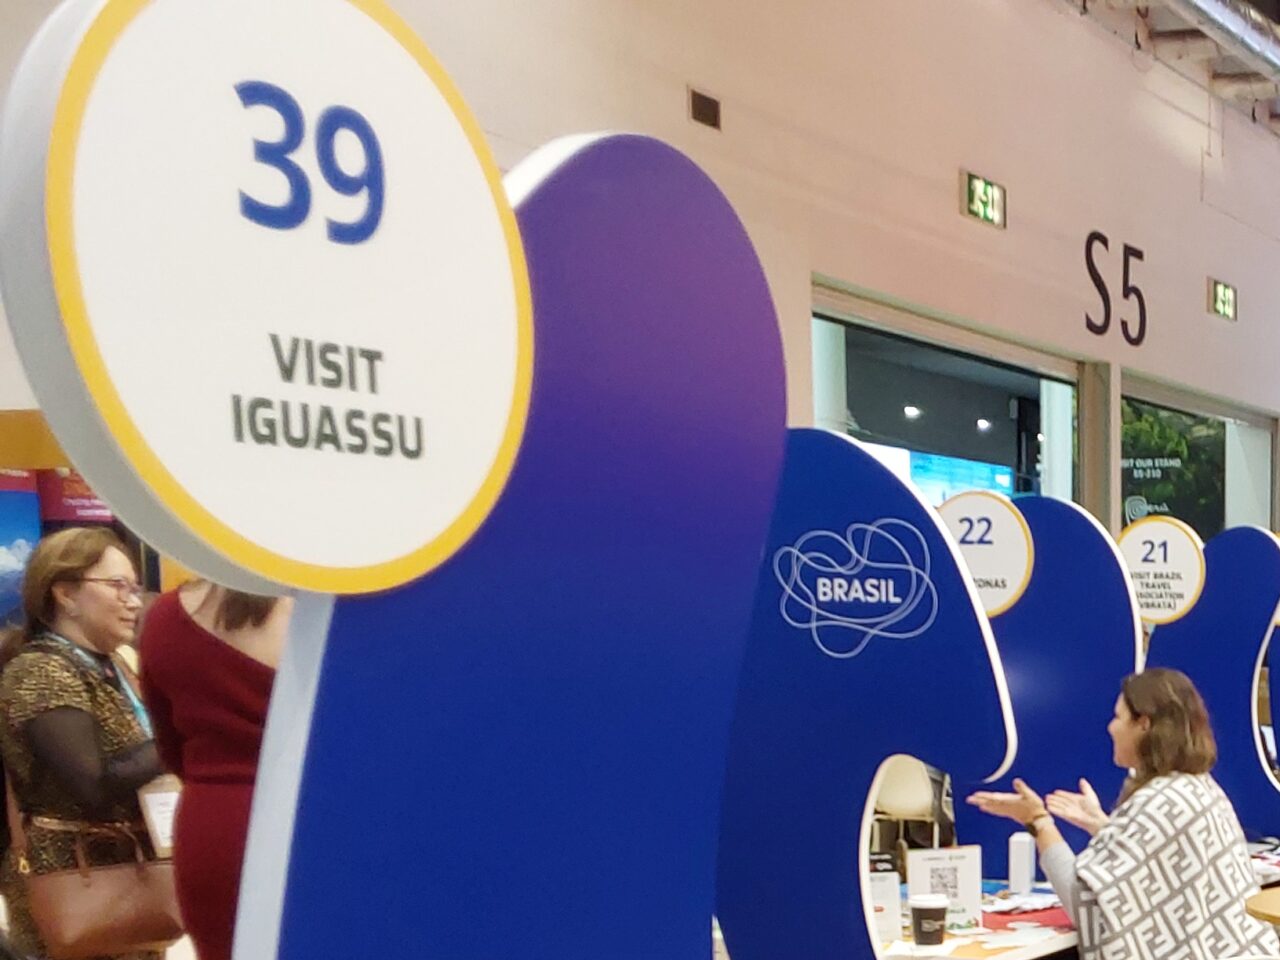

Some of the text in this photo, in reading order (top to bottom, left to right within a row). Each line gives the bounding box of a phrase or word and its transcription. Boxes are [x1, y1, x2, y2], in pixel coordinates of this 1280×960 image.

[234, 80, 385, 245] 39
[1085, 230, 1146, 346] S5
[269, 333, 383, 394] VISIT
[231, 394, 425, 460] IGUASSU
[958, 517, 993, 545] 22
[1141, 540, 1169, 564] 21
[816, 576, 903, 604] BRASIL
